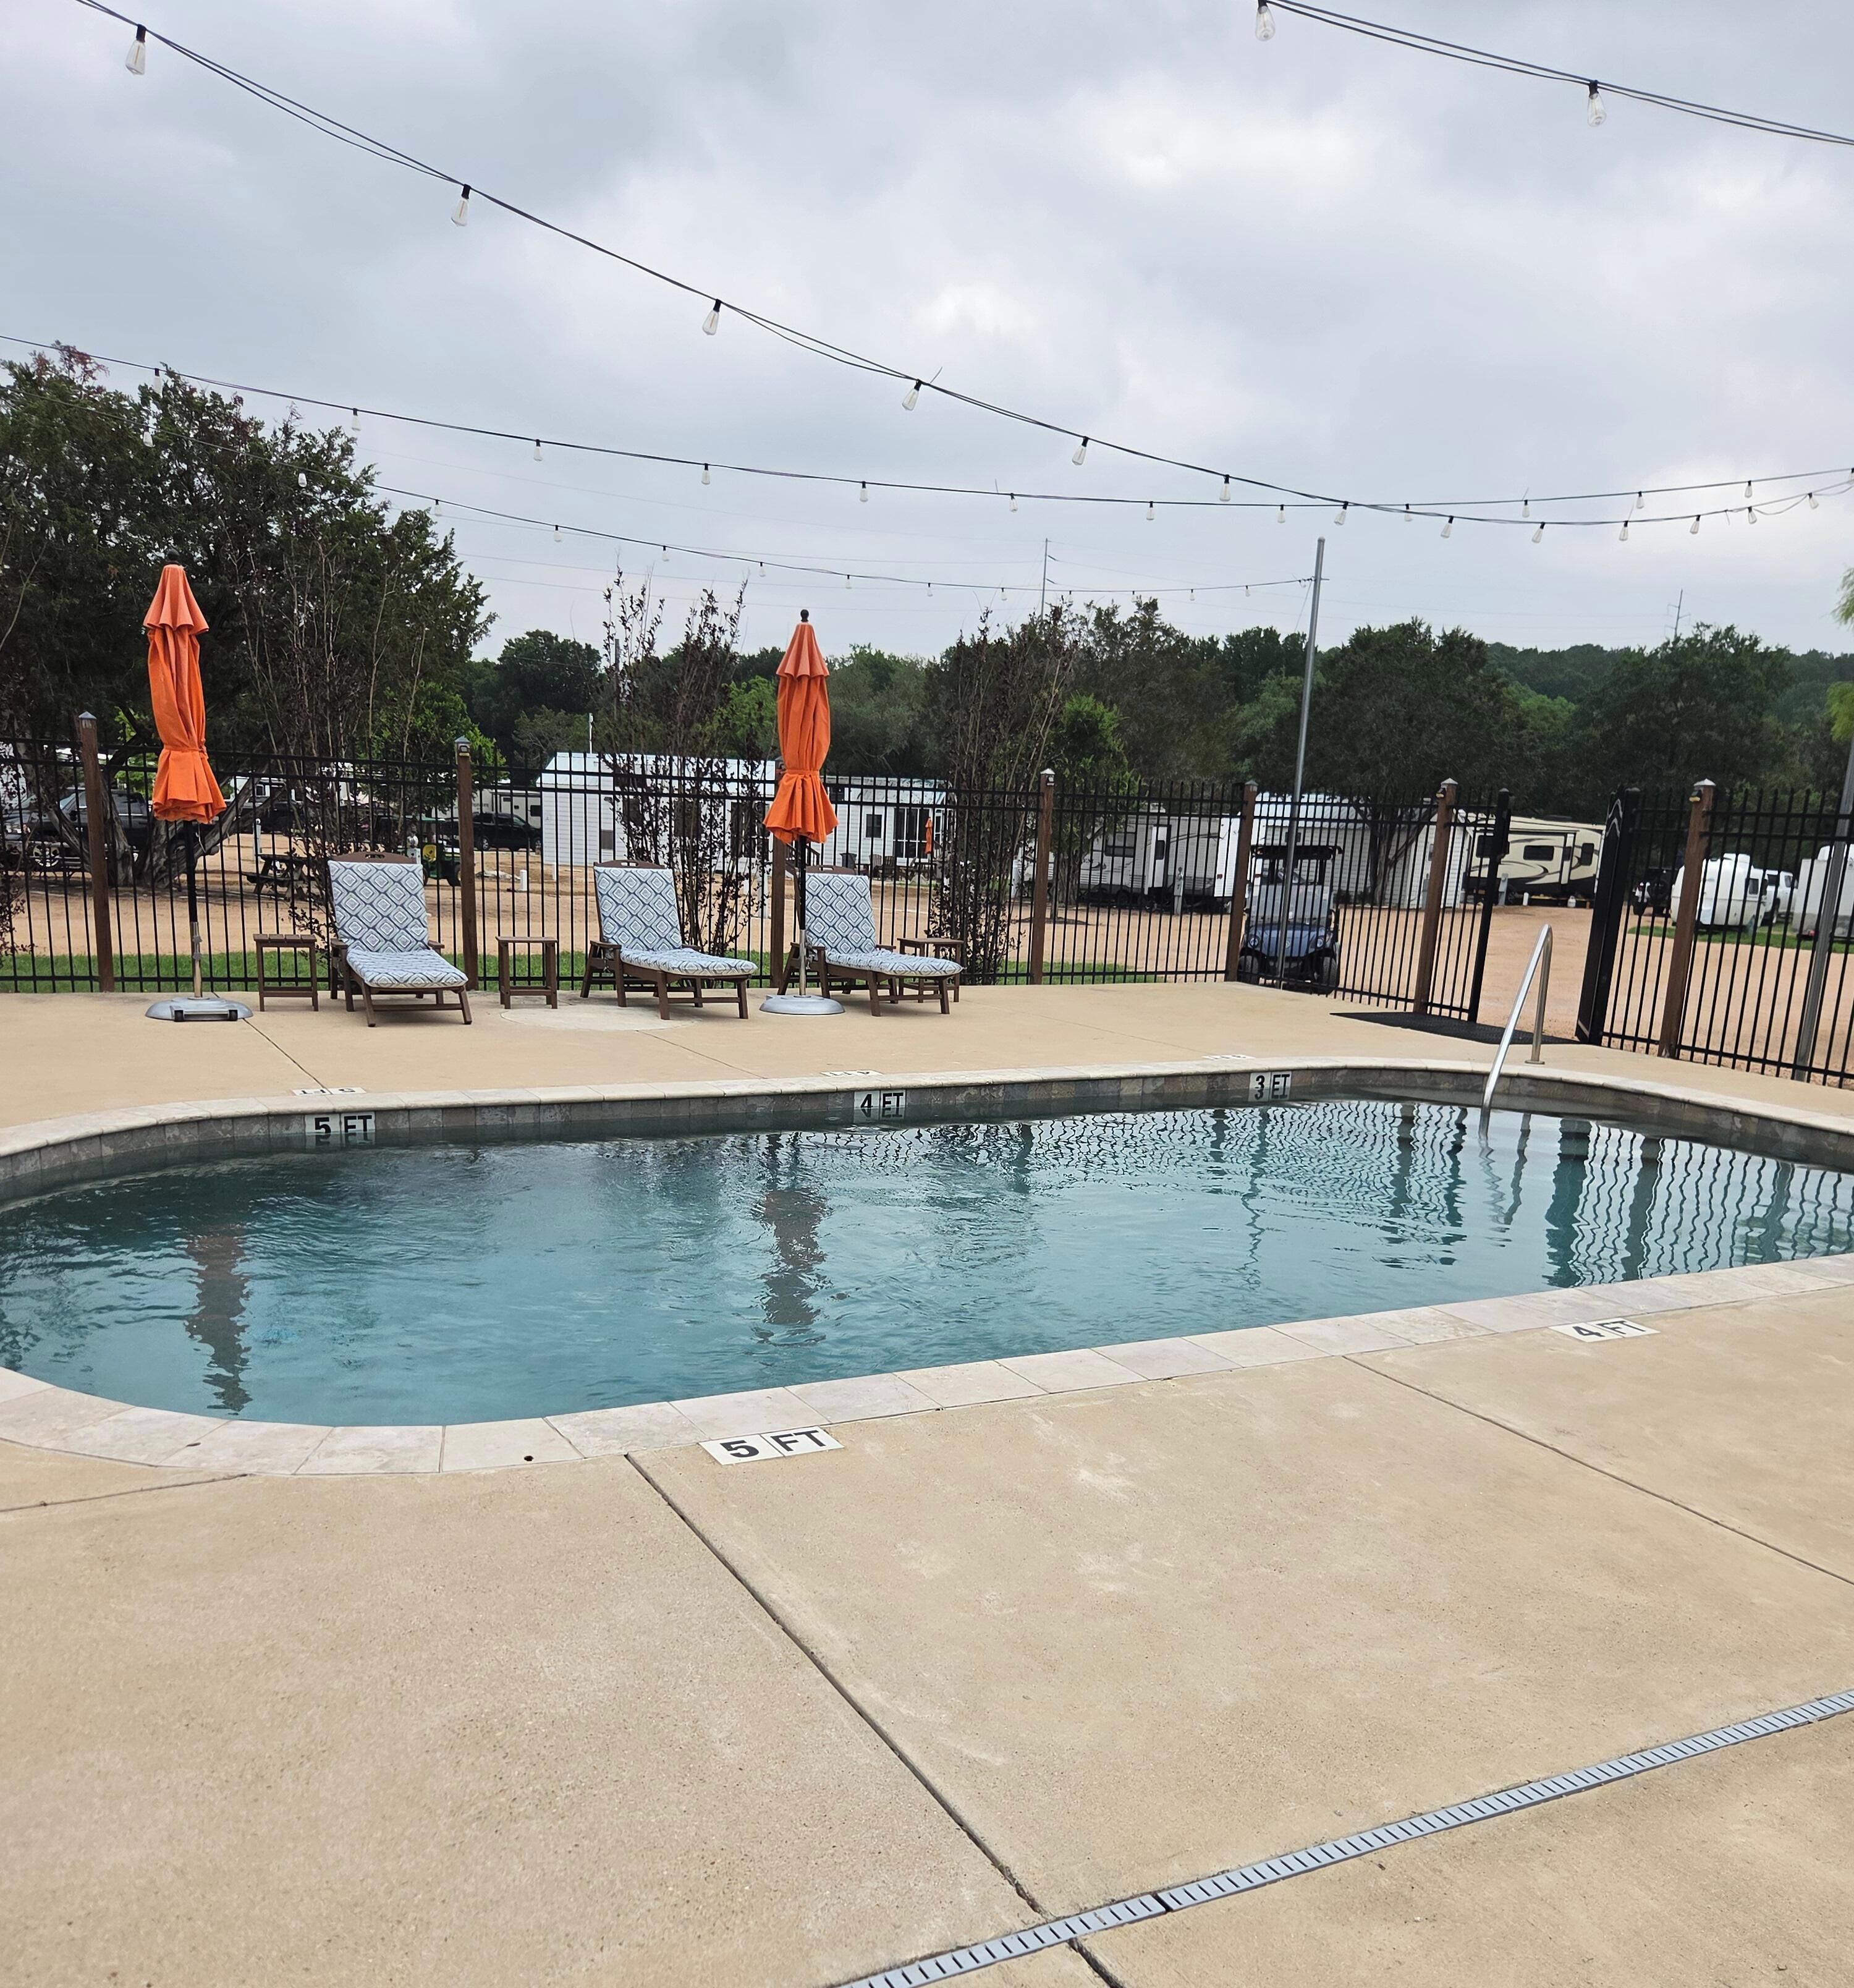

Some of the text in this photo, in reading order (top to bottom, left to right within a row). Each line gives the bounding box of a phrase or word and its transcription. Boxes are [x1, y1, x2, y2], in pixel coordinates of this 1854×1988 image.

[1254, 1074, 1266, 1090] 3
[860, 1092, 904, 1108] 4 FT
[315, 1115, 373, 1134] 5 FT
[1572, 1320, 1647, 1338] 4 FT
[719, 1429, 827, 1458] 5 FT
